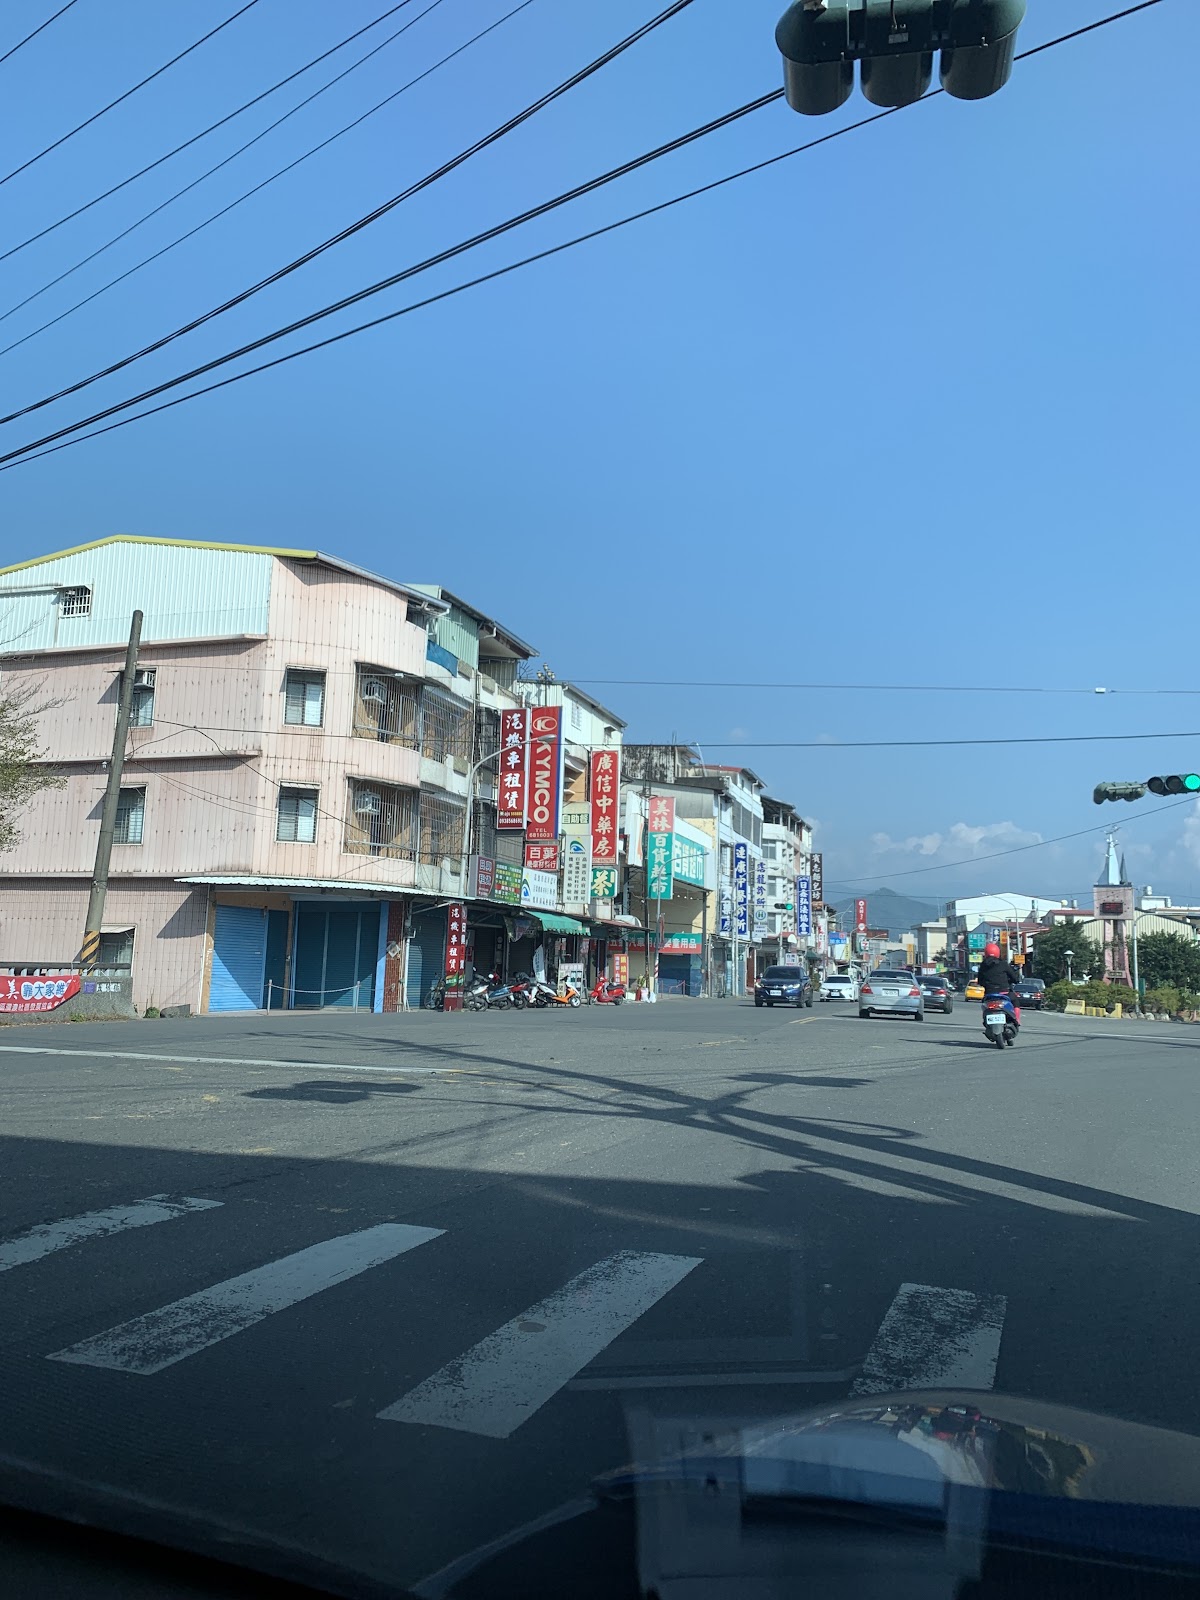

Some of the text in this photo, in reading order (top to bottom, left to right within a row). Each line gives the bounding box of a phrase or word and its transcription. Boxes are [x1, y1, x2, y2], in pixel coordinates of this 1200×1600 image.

[593, 753, 614, 856] 廣信中藥房
[591, 869, 612, 896] 茶
